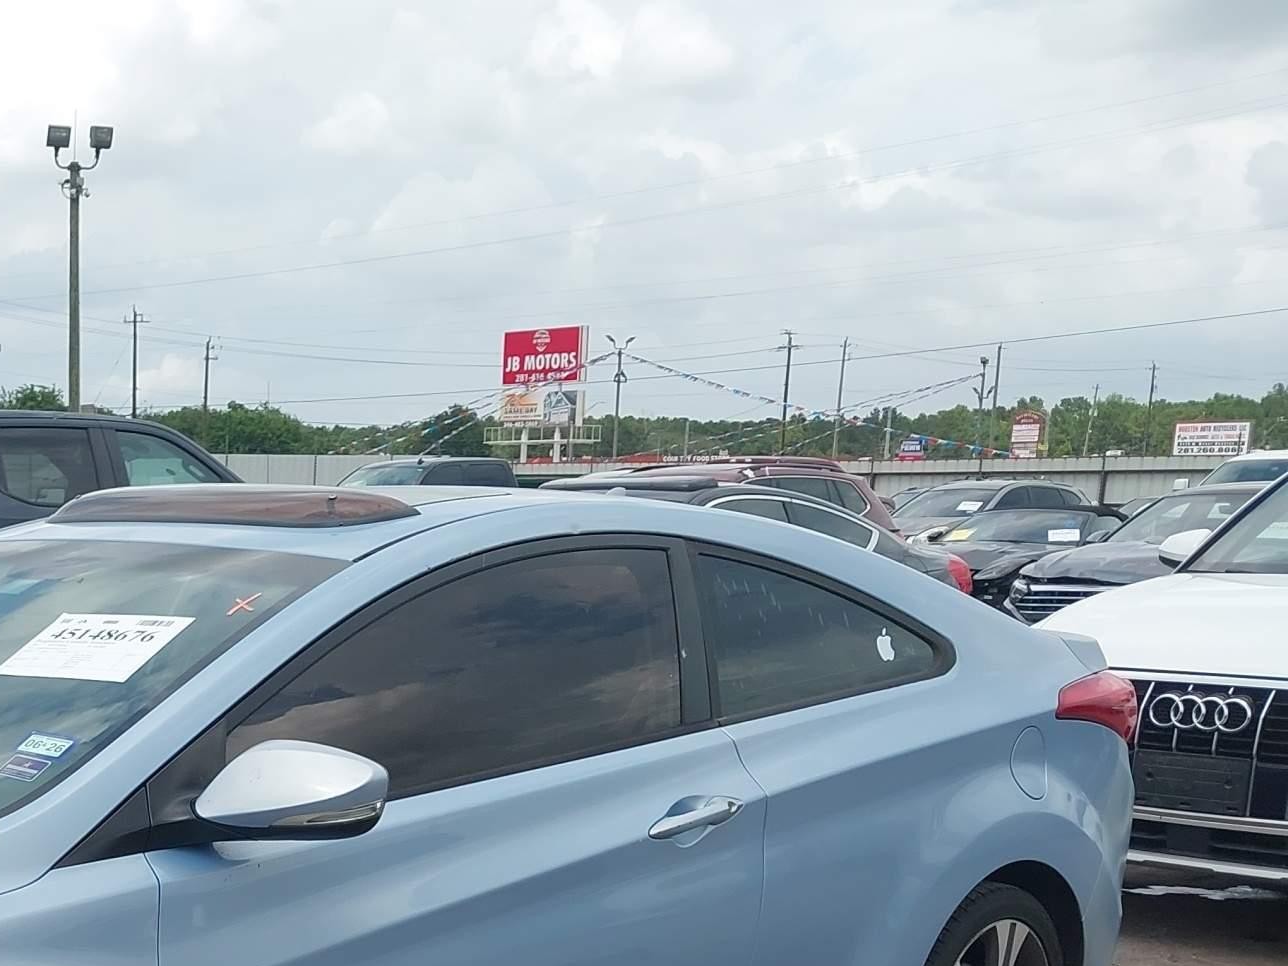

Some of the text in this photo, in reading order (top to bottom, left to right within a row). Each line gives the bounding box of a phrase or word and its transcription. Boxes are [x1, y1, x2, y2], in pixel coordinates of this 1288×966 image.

[505, 352, 577, 372] JB MOTORS
[51, 627, 160, 643] 45148676
